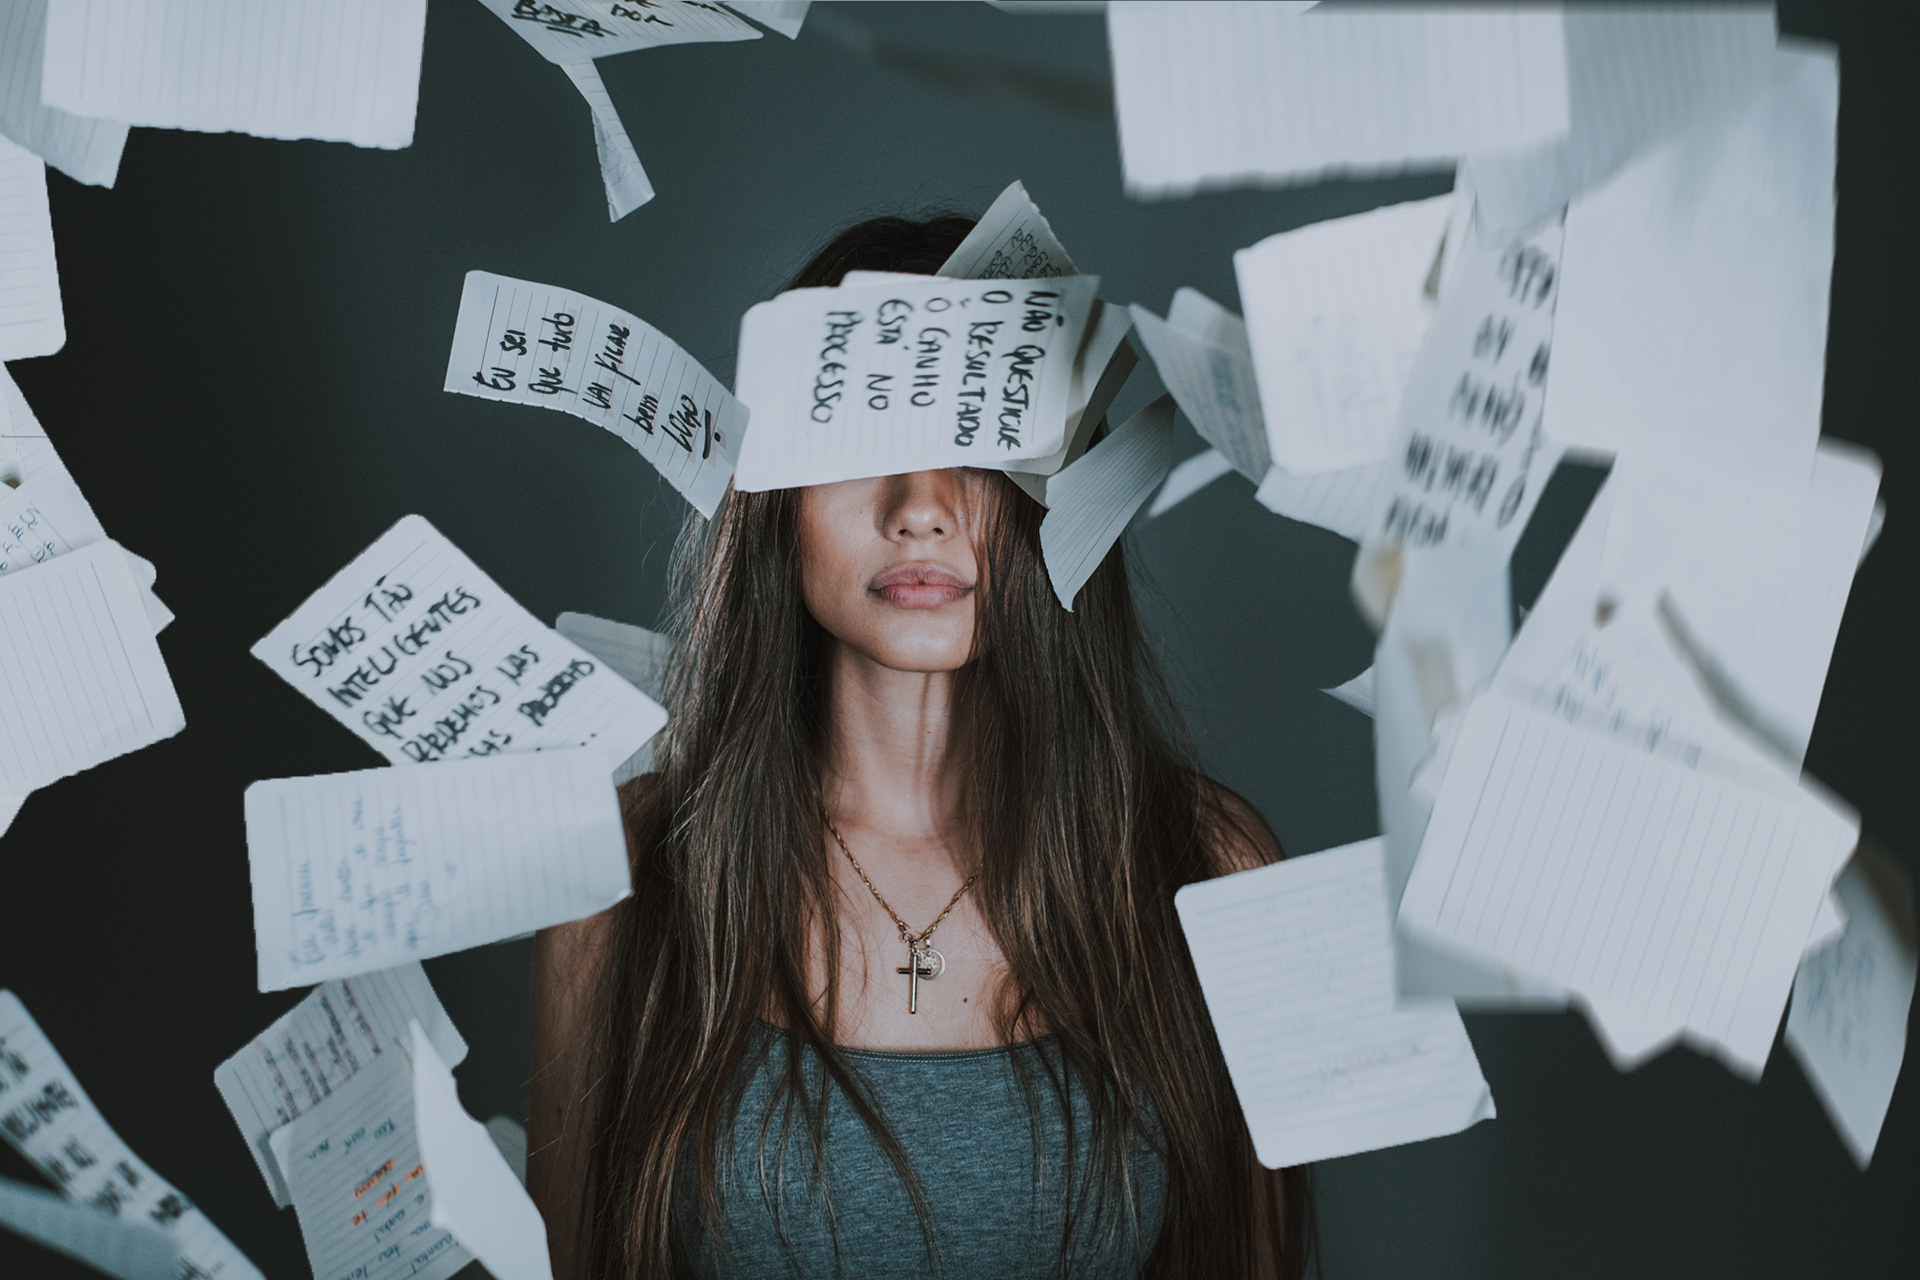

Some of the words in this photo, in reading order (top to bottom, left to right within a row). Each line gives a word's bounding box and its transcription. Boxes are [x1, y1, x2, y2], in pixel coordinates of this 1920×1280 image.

[875, 298, 916, 352] ESTÁ
[981, 289, 1014, 305] O
[1021, 290, 1065, 333] NÃO
[810, 309, 865, 424] PROCESSO
[866, 374, 894, 411] NO
[909, 326, 952, 408] GANHO
[953, 320, 1006, 447] RESULTADO
[293, 616, 367, 679] SOMOS
[326, 585, 483, 709] INTELIGENTES
[361, 695, 419, 741] QUE
[421, 650, 474, 695] NOS
[400, 684, 503, 763] PERDEMOS
